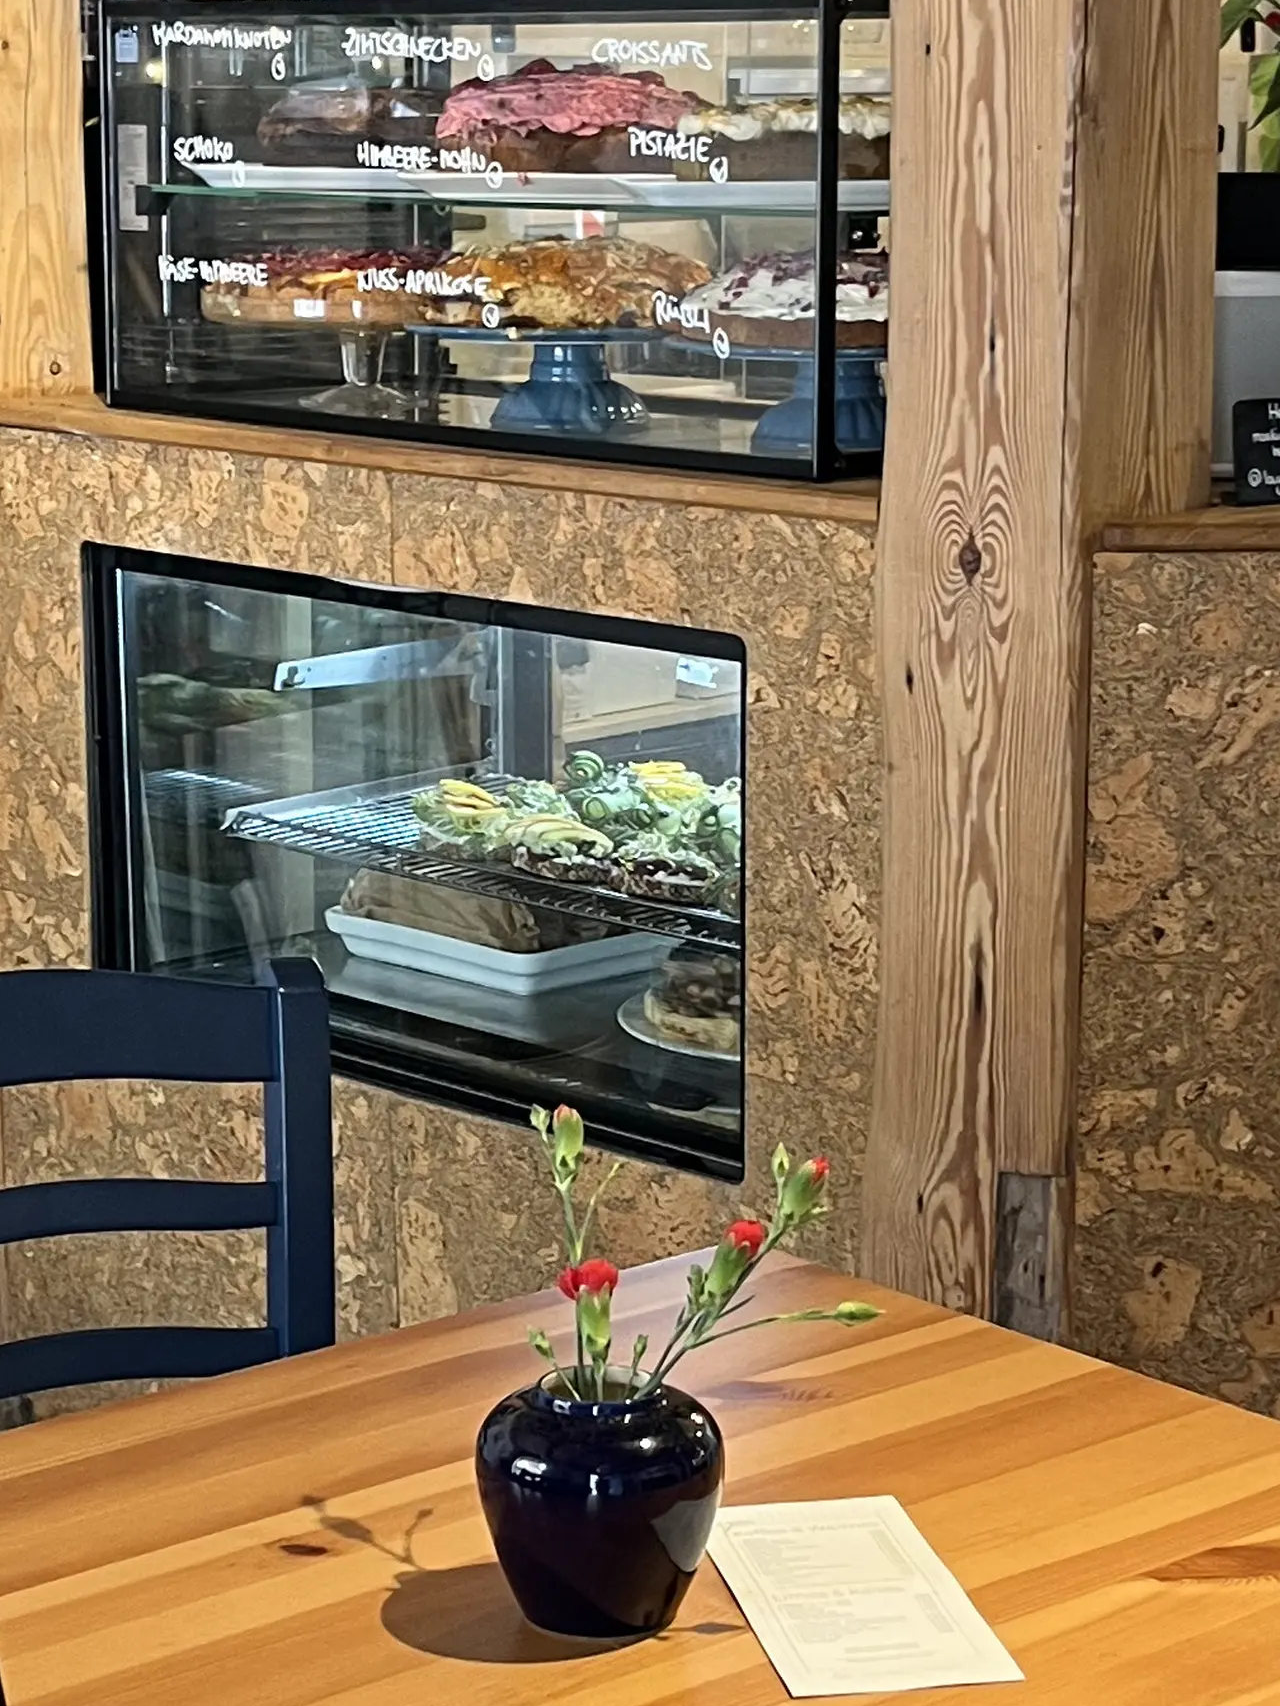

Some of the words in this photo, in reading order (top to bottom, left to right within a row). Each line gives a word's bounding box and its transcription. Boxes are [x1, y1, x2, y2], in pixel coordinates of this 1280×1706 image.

[591, 38, 713, 71] CROISSANTS
[173, 135, 234, 163] SCHOKO
[627, 126, 713, 163] PISTAZIE
[357, 267, 492, 296] NUSS-APRIKOSE
